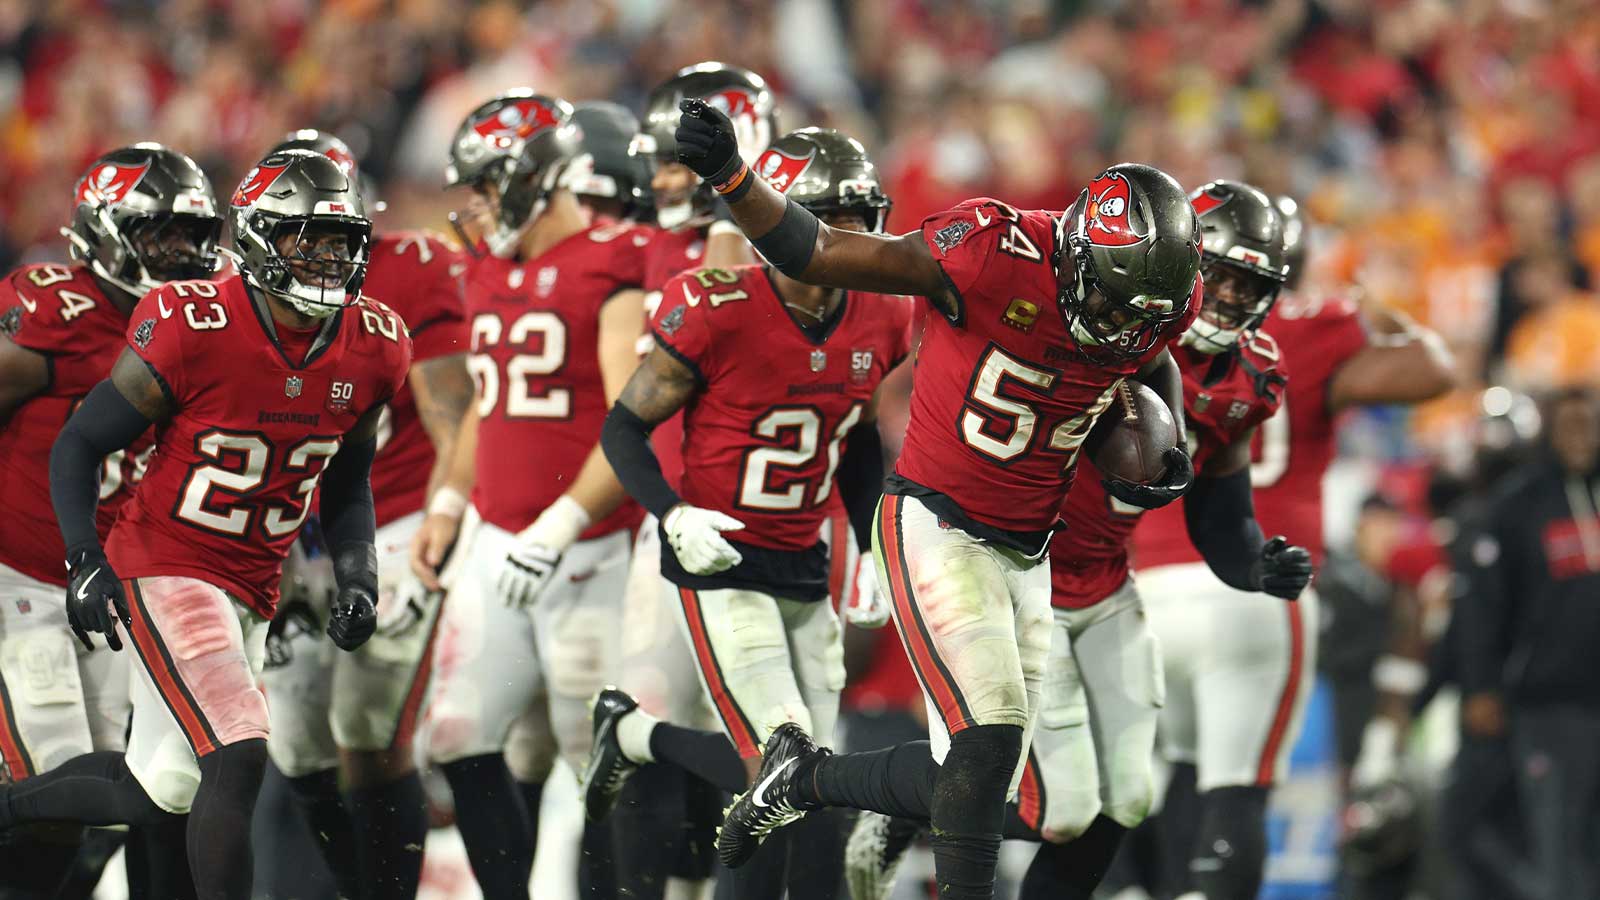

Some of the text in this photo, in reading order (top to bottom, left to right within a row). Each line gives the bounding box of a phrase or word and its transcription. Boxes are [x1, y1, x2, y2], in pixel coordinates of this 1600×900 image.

[27, 265, 96, 321] 94
[171, 282, 228, 331] 23
[696, 267, 749, 307] 21
[465, 312, 569, 417] 62
[851, 351, 873, 370] 50
[331, 381, 353, 400] 50
[960, 346, 1126, 471] 54
[177, 430, 341, 538] 23
[739, 403, 862, 511] 21
